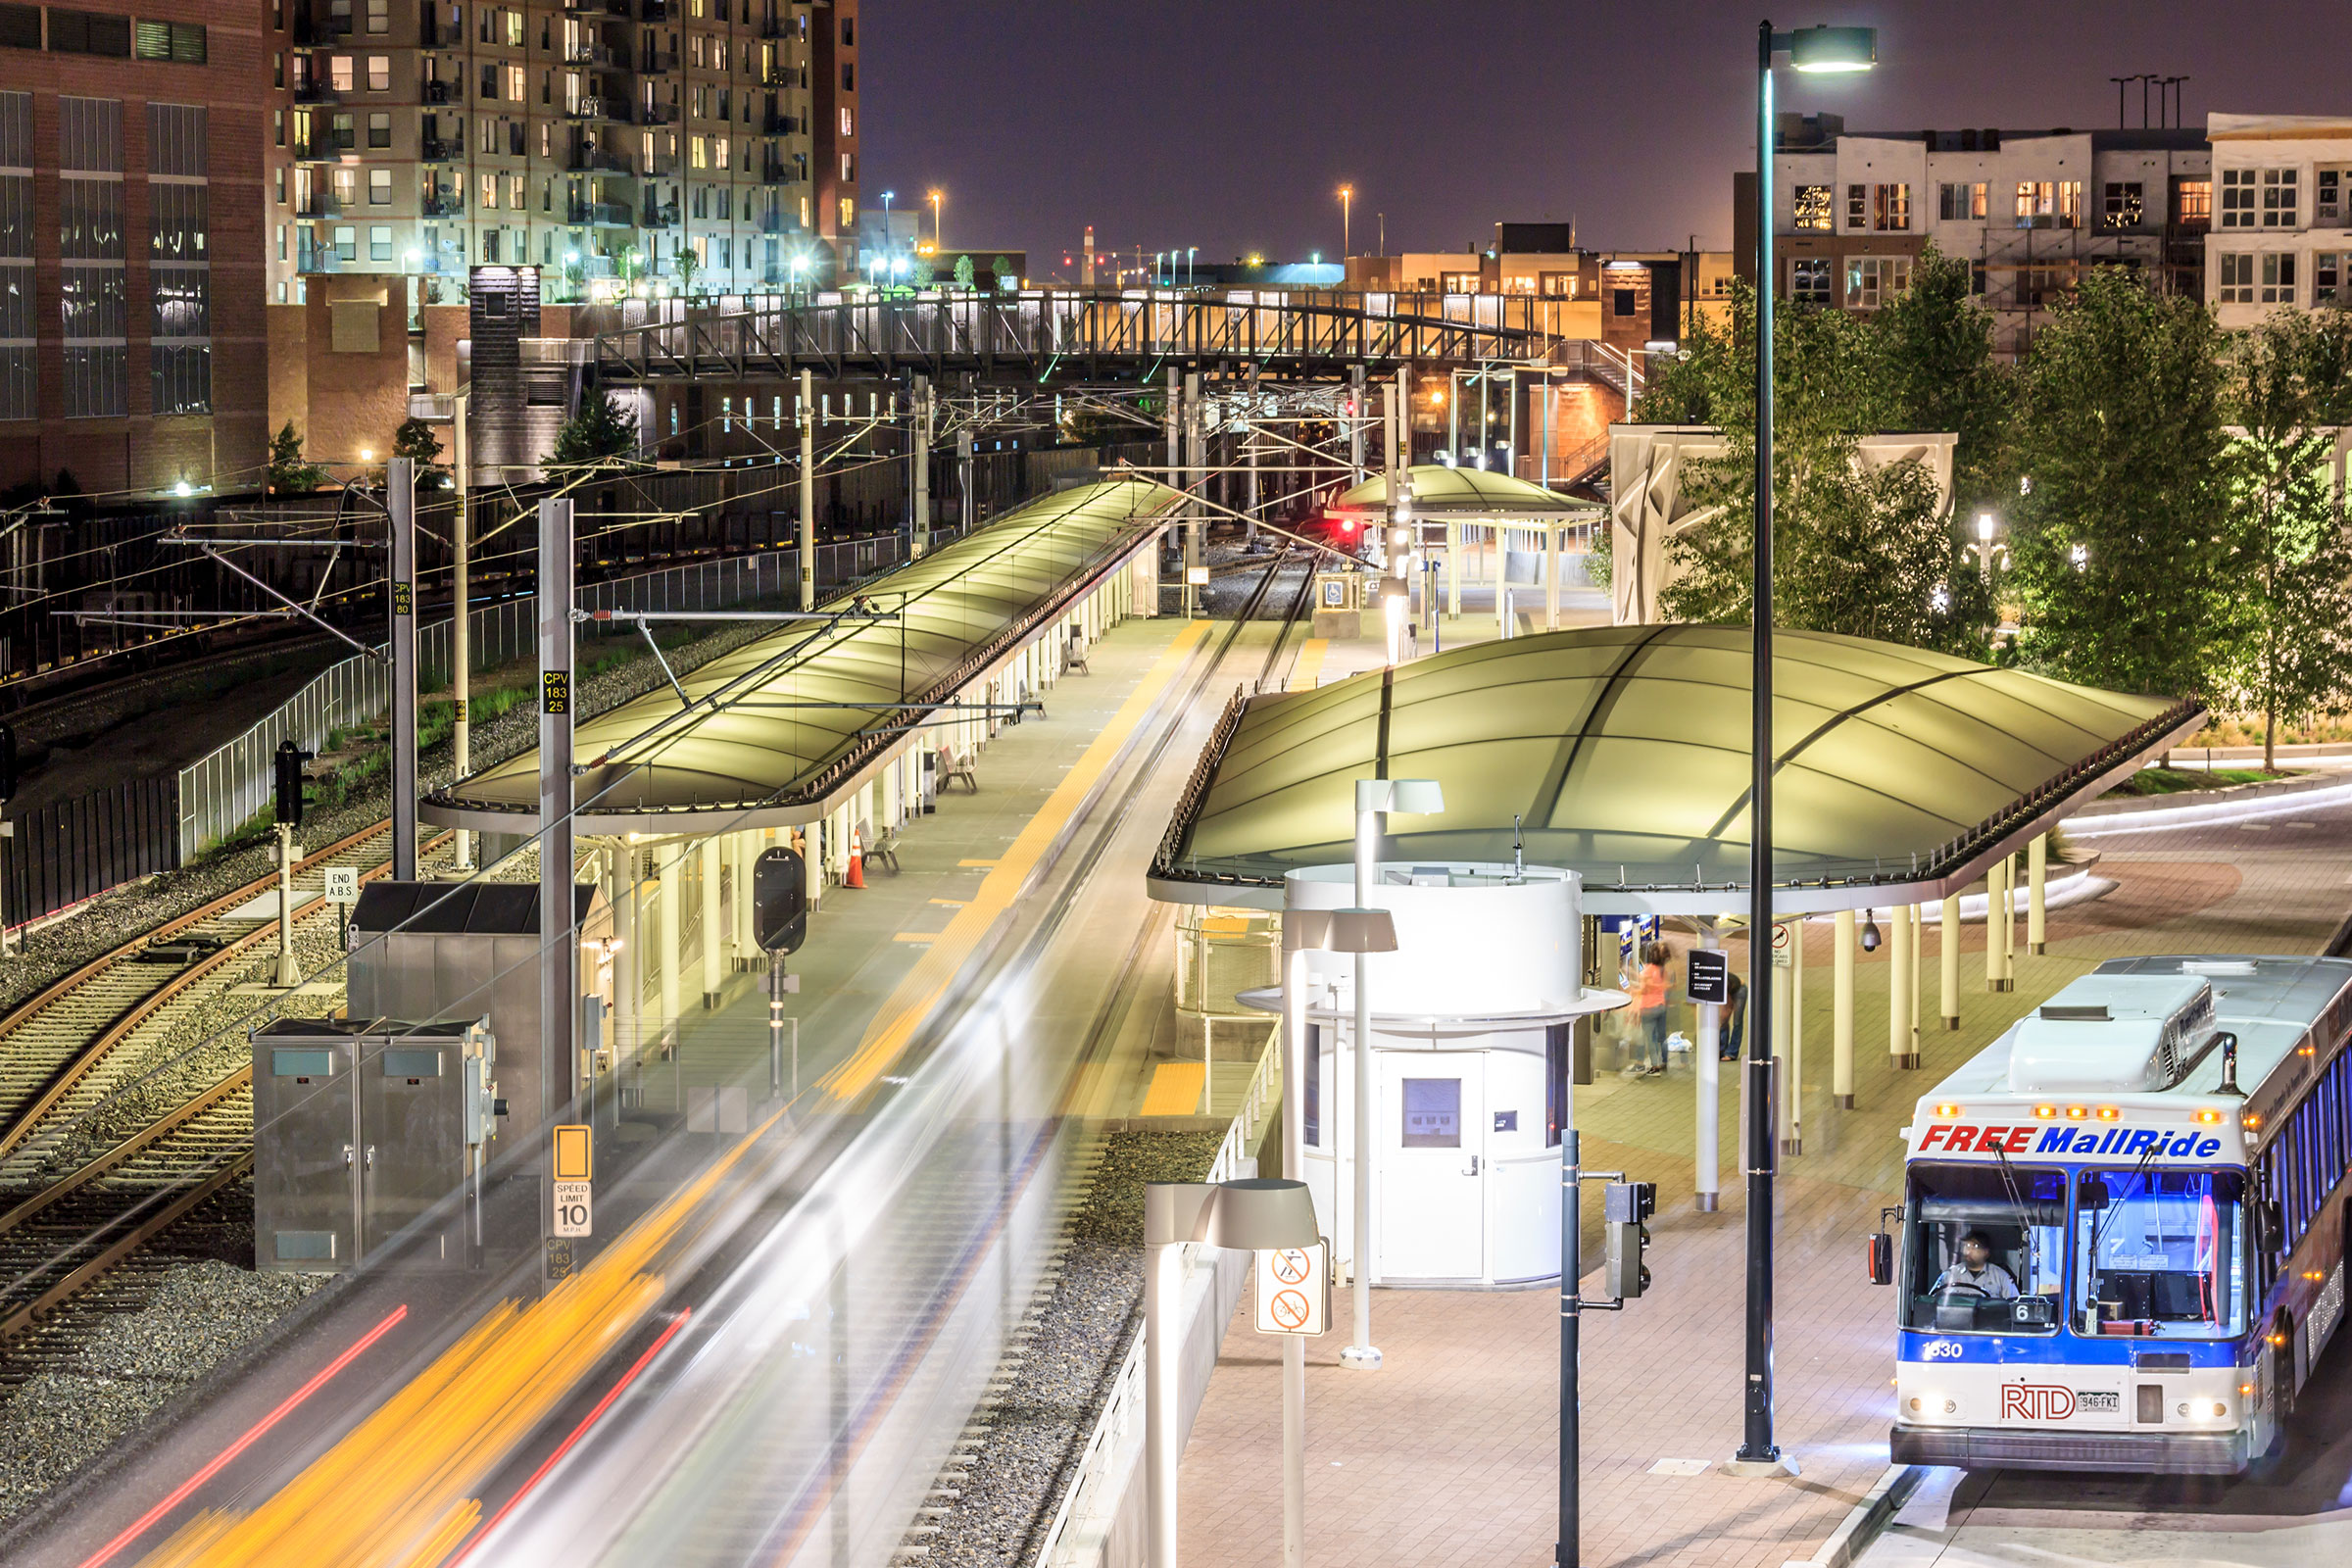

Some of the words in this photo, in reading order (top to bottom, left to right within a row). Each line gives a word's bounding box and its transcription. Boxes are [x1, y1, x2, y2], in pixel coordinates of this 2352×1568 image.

[395, 594, 411, 604] 183
[396, 605, 409, 614] 80
[544, 672, 568, 684] CPV
[546, 687, 567, 699] 183
[549, 700, 564, 712] 25
[332, 873, 350, 884] END
[329, 886, 354, 897] A.B.S.
[1918, 1125, 2038, 1153] FREE
[2034, 1127, 2223, 1158] MallRide
[557, 1184, 588, 1193] SPEED
[558, 1204, 588, 1226] 10
[547, 1239, 570, 1250] CPV
[549, 1253, 569, 1264] 183
[2016, 1304, 2029, 1321] 6
[2001, 1384, 2076, 1420] RTD
